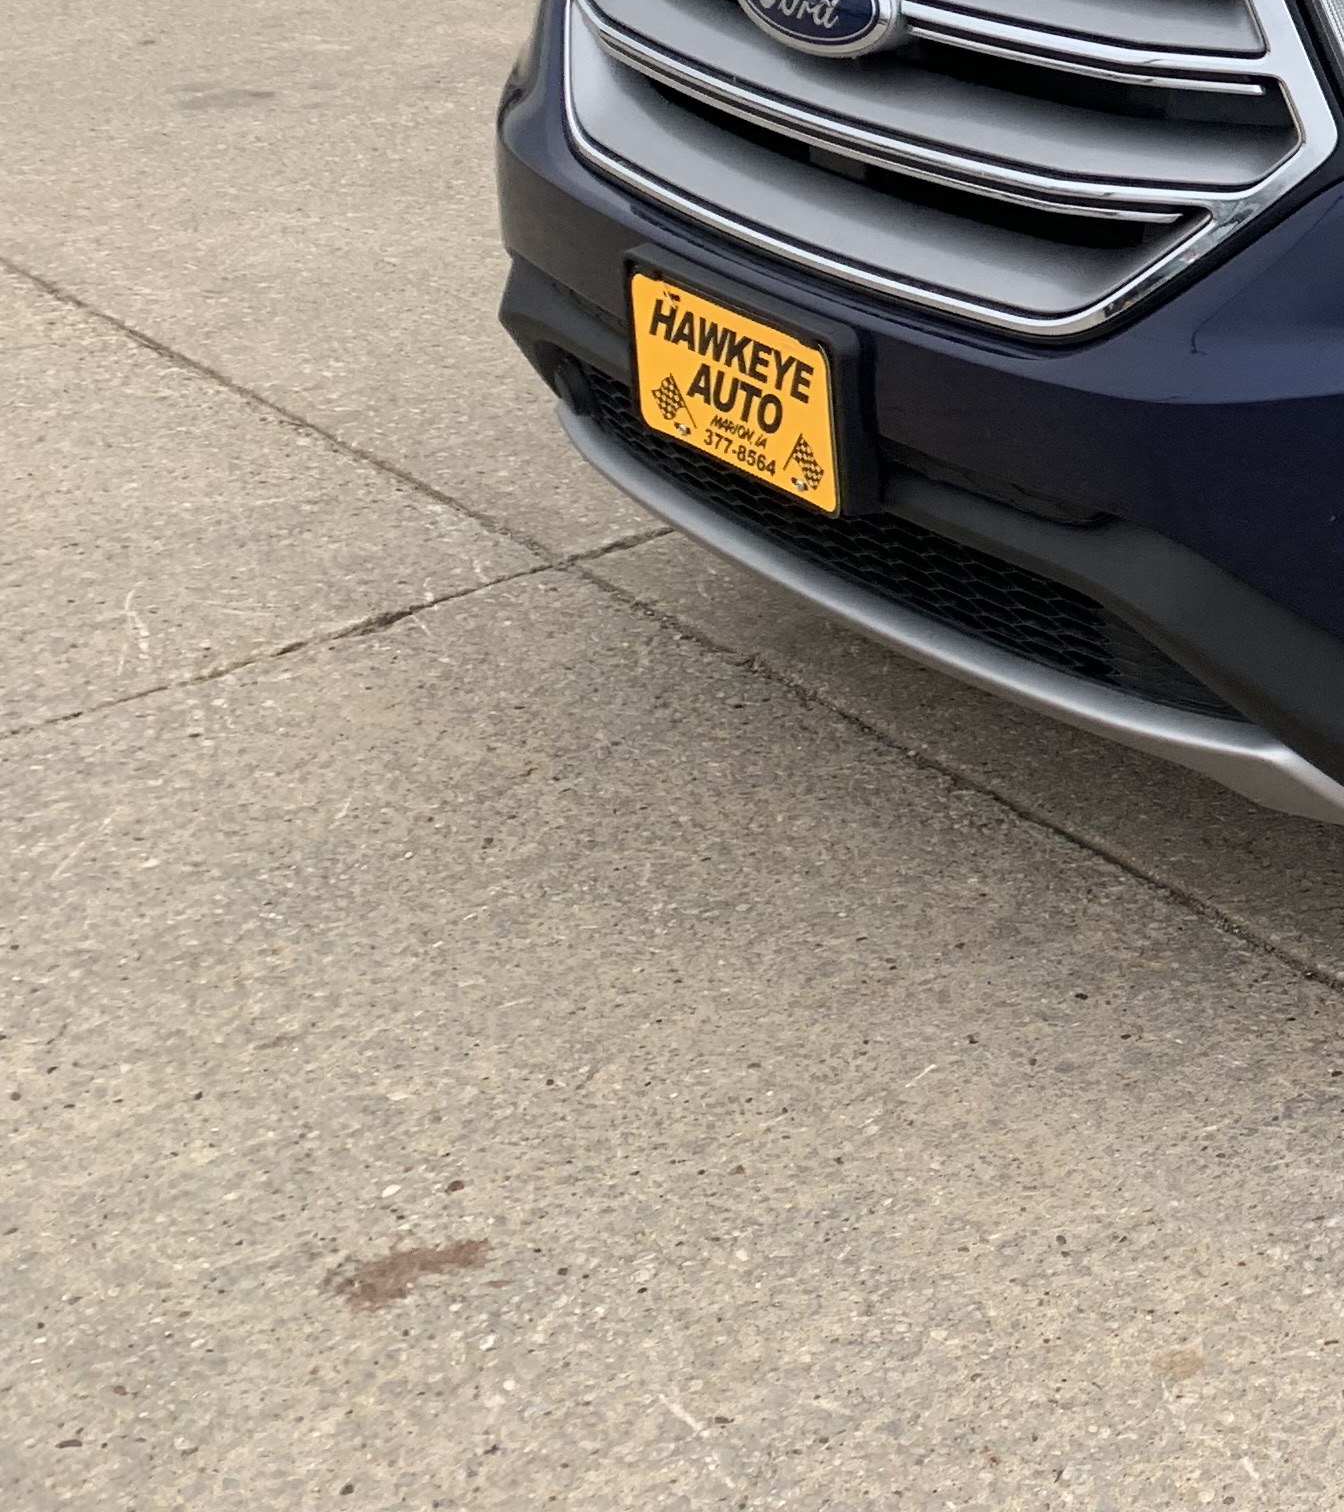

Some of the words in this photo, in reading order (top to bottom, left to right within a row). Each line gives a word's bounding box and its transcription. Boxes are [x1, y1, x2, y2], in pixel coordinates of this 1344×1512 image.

[649, 299, 815, 404] HAWKEYE
[686, 362, 783, 434] AUTO
[703, 428, 776, 477] 377-8564
